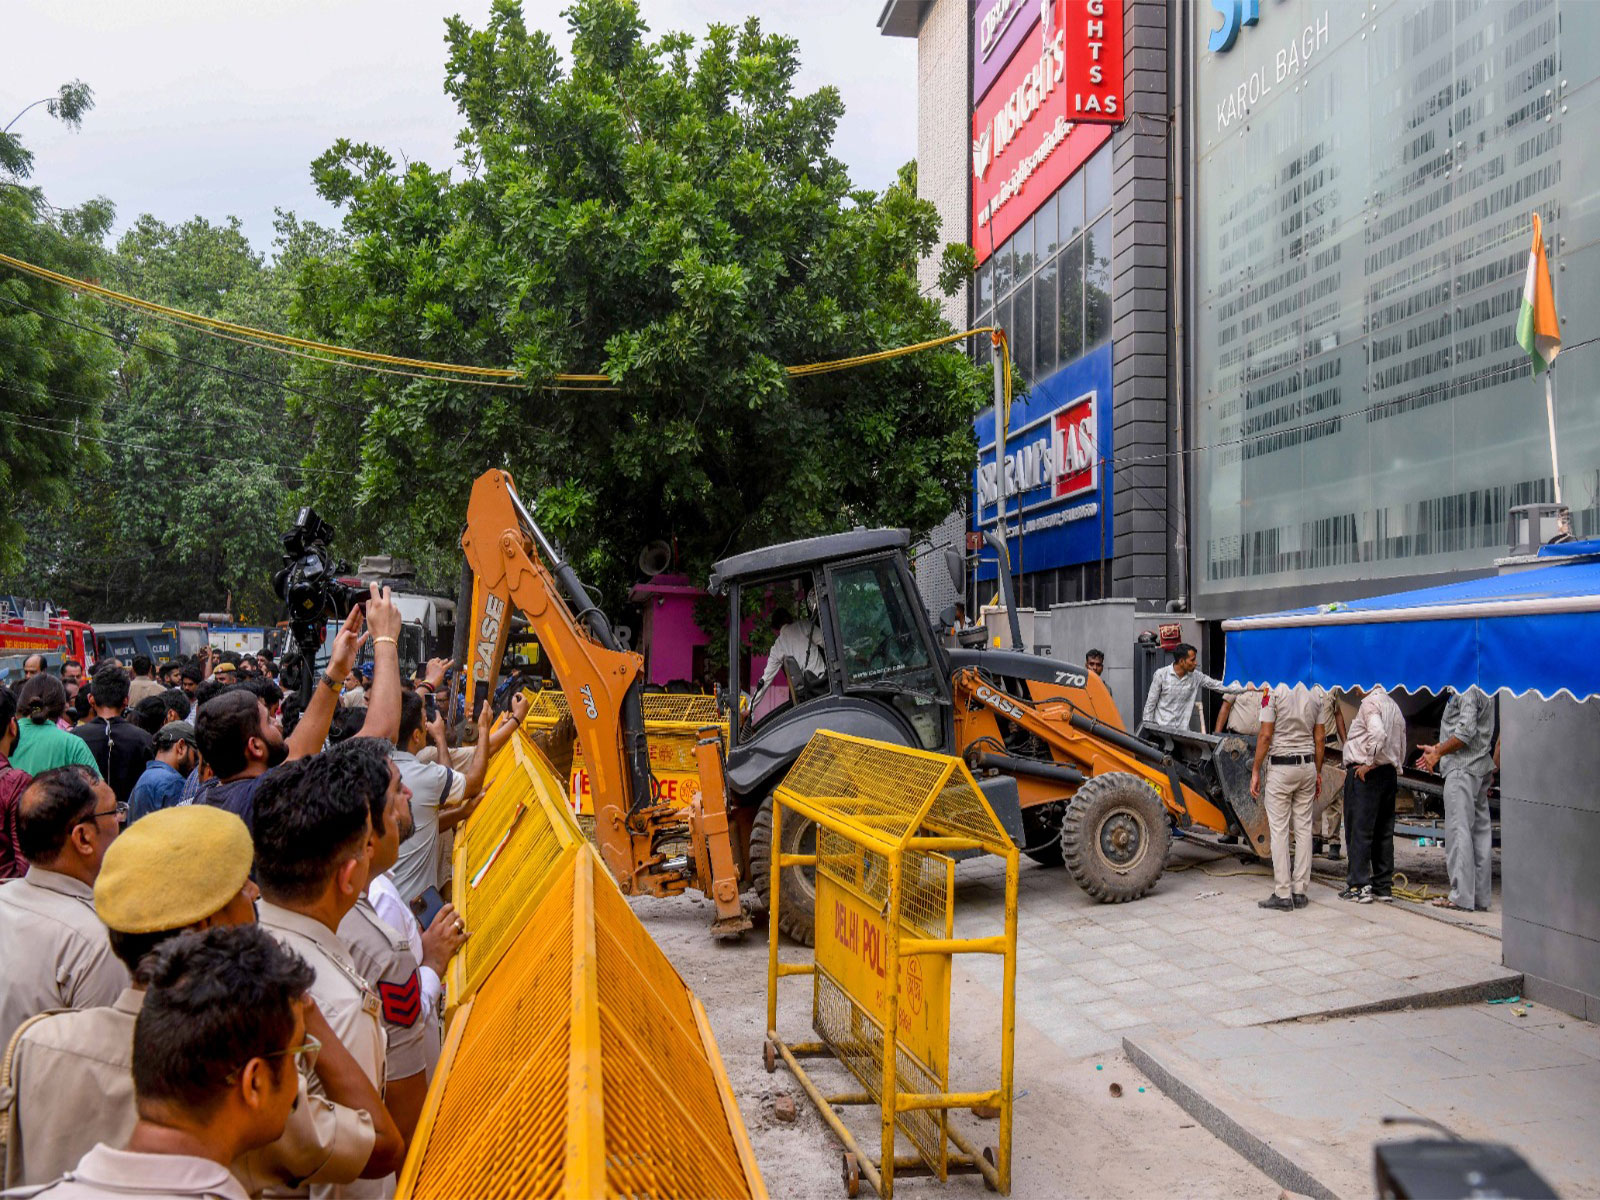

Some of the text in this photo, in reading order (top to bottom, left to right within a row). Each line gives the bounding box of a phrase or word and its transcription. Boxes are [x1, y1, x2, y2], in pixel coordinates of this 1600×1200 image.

[994, 29, 1064, 158] INSIGHTS
[1217, 66, 1271, 132] KAROL
[1276, 9, 1328, 83] BAGH
[1075, 94, 1117, 113] IAS
[1056, 417, 1093, 476] IAS
[473, 592, 505, 683] CASE
[580, 684, 599, 720] 770
[976, 686, 1025, 720] CASE
[1055, 671, 1086, 687] 770
[835, 900, 859, 956] DELHI
